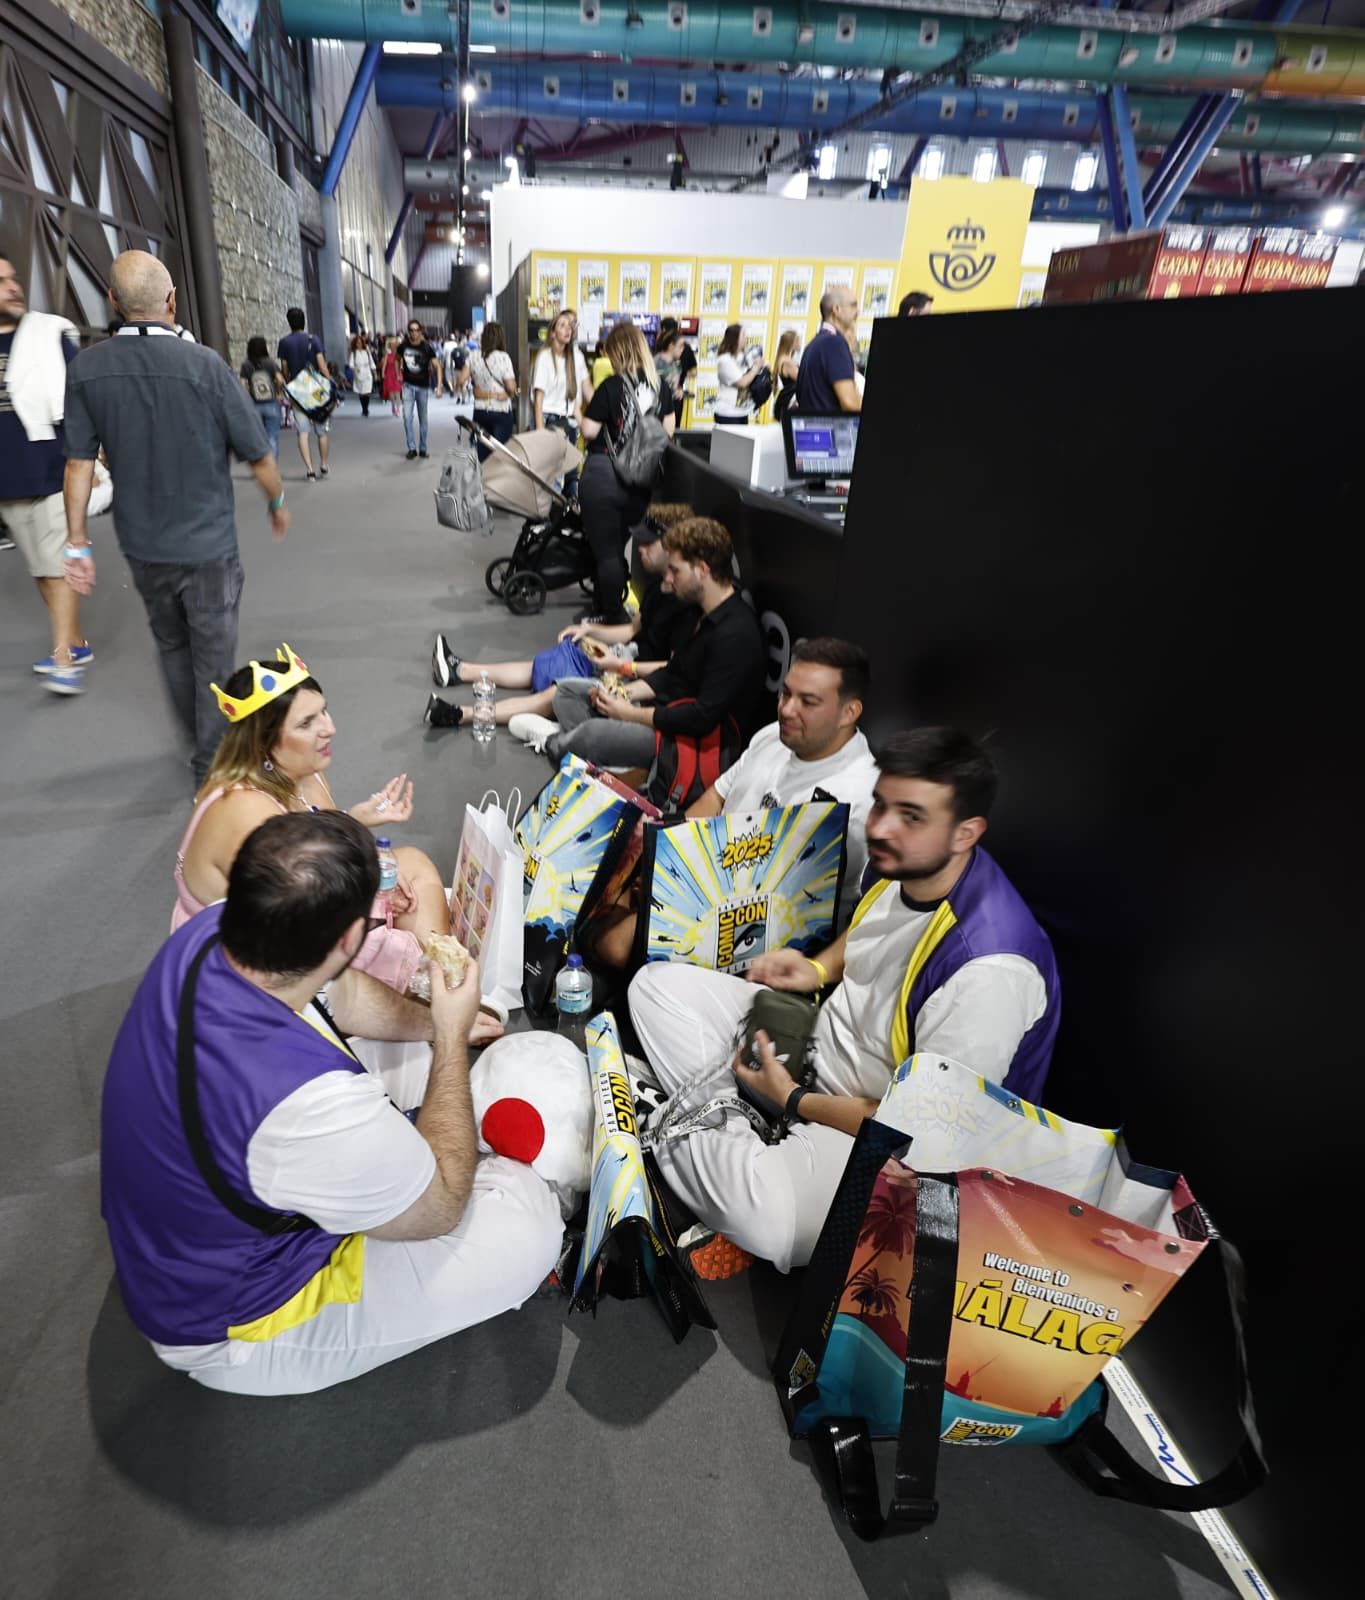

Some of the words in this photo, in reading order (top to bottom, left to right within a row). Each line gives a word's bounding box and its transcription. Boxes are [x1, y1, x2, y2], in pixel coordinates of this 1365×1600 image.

[1159, 255, 1200, 276] CATAN
[1204, 257, 1246, 279] CATAN
[1253, 258, 1296, 281] CATAN
[722, 833, 773, 870] 2025
[735, 901, 768, 926] CON
[718, 911, 735, 968] COMIC
[600, 1071, 612, 1105] DIEGO
[610, 1072, 634, 1115] CON
[984, 1252, 1051, 1282] Welcome
[1053, 1270, 1071, 1287] to
[1012, 1278, 1105, 1317] Bienvenidos
[1106, 1307, 1119, 1321] a
[952, 1279, 1126, 1356] ÁLAG
[975, 1425, 1015, 1437] CON
